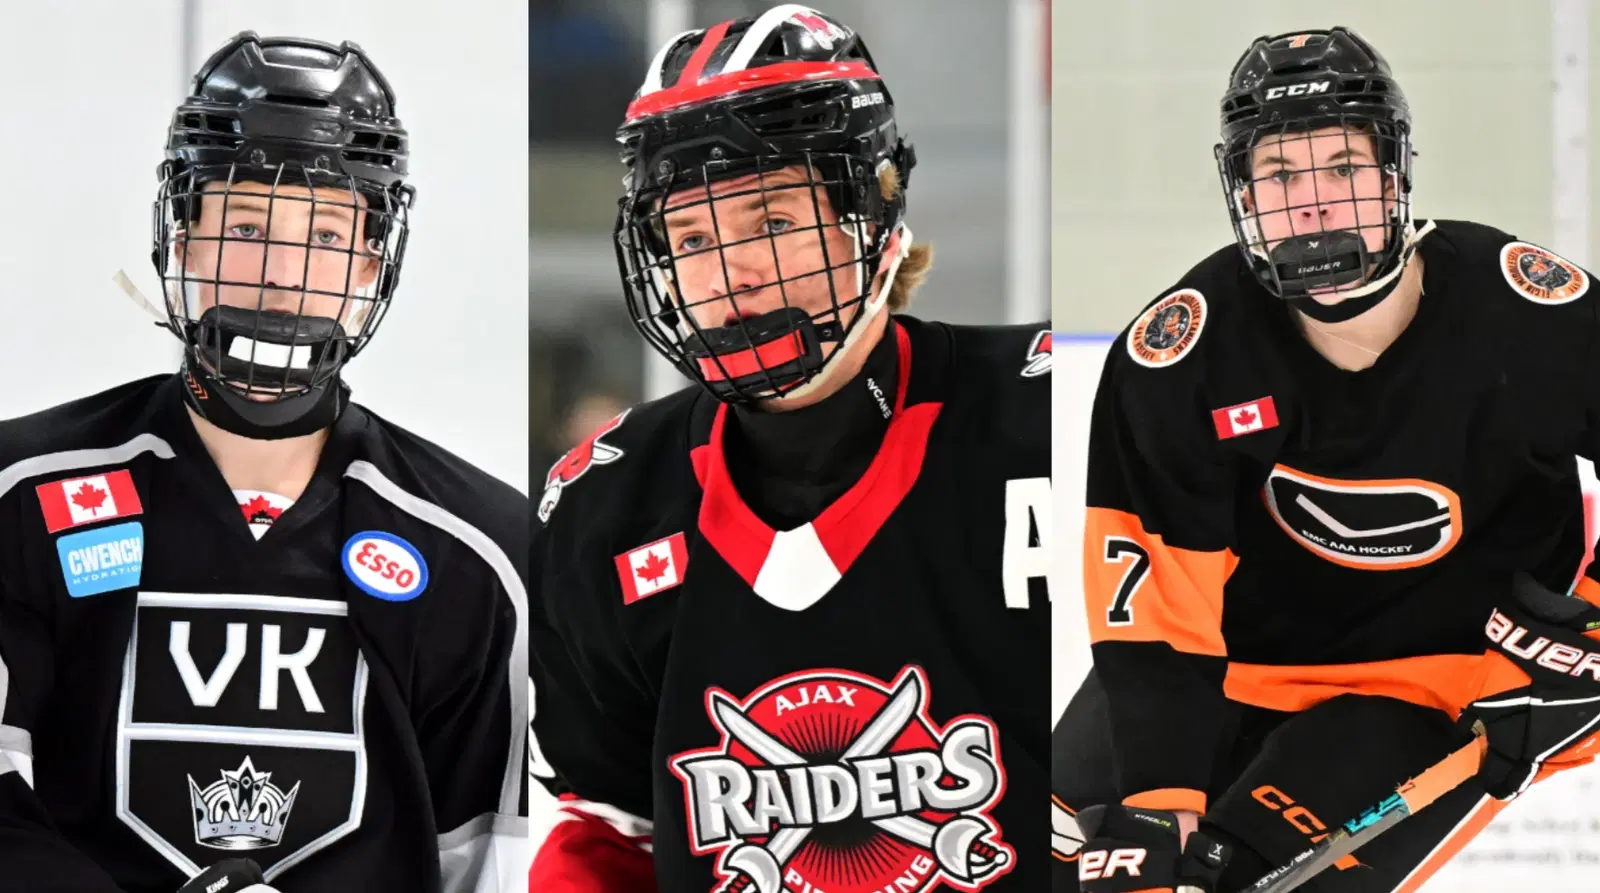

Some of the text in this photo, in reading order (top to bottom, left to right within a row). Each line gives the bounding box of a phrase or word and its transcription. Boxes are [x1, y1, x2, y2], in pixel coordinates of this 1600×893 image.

[1265, 81, 1330, 100] CCM
[68, 537, 141, 576] CWENCH
[1002, 477, 1052, 609] A
[1302, 529, 1412, 554] EMC AAA HOCKEY
[1104, 535, 1151, 627] 7
[169, 621, 327, 713] VK
[775, 685, 858, 716] AJAX
[683, 721, 999, 844] RAIDERS
